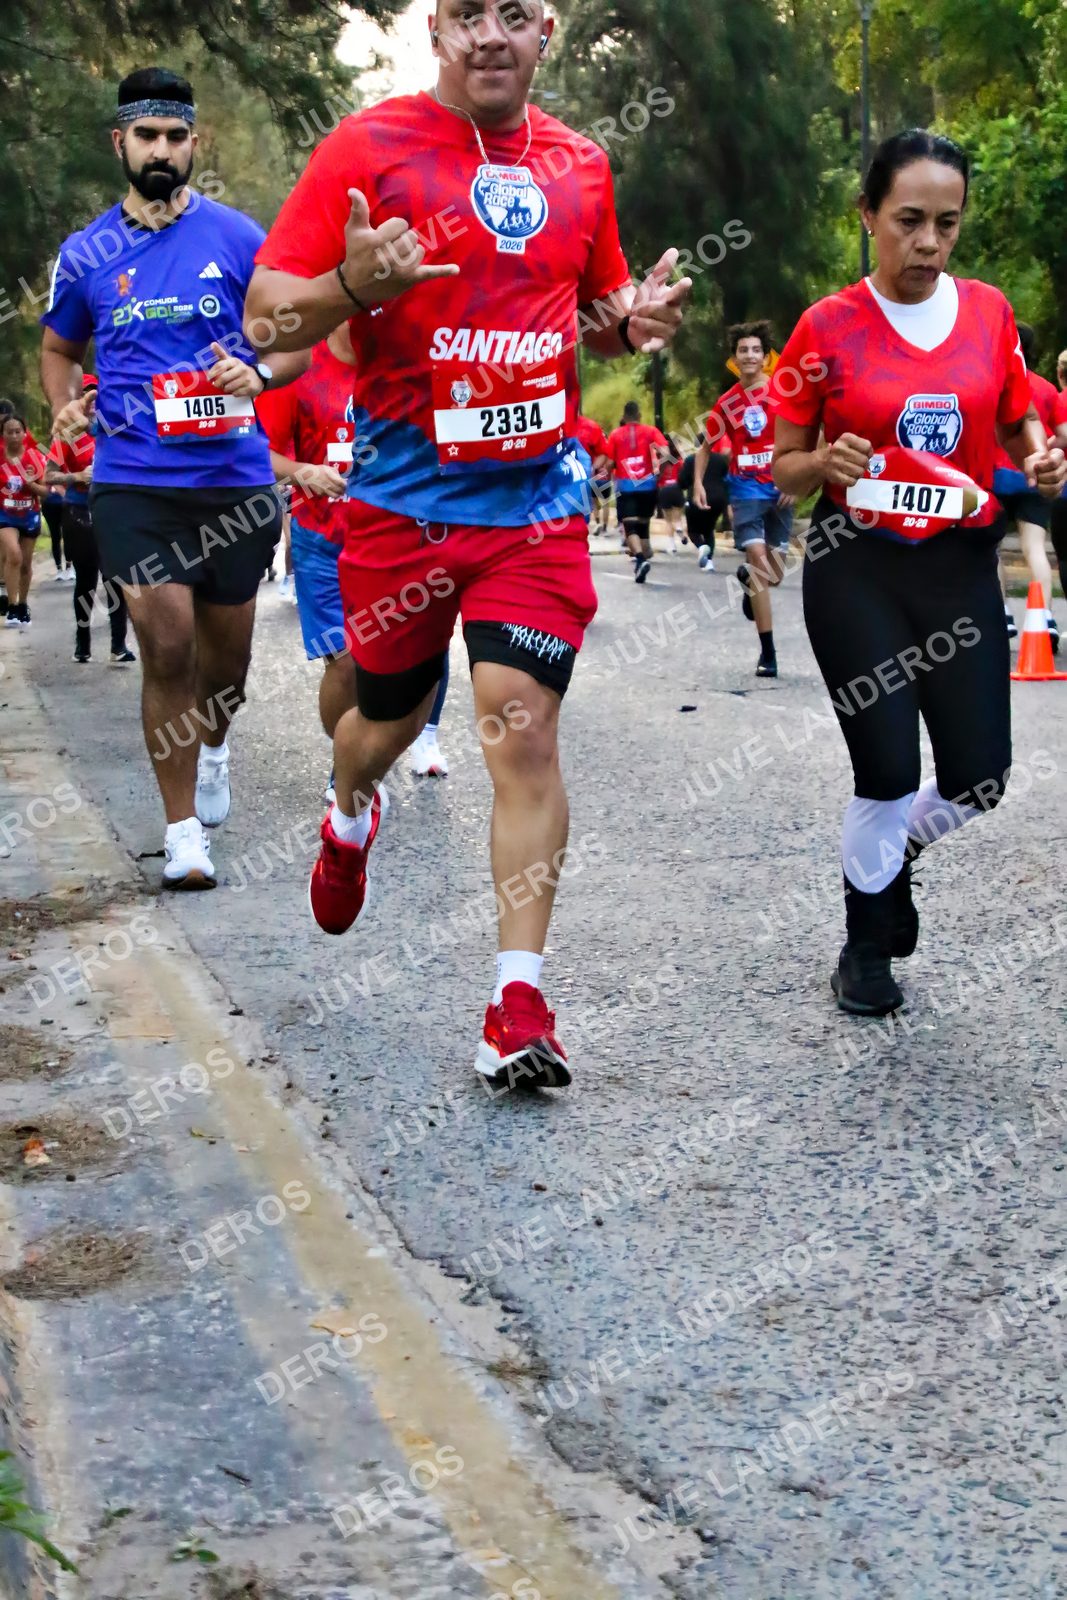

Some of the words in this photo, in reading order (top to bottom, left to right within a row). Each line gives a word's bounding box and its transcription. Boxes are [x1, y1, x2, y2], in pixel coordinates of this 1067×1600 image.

[490, 182, 528, 198] Global
[484, 191, 515, 208] Race
[499, 239, 523, 251] 2026
[144, 297, 178, 306] COMUDE
[184, 397, 225, 418] 1405
[913, 401, 951, 409] BIMBO
[480, 402, 543, 437] 2334
[914, 413, 949, 425] Global
[907, 424, 935, 435] Race
[892, 484, 946, 513] 1407
